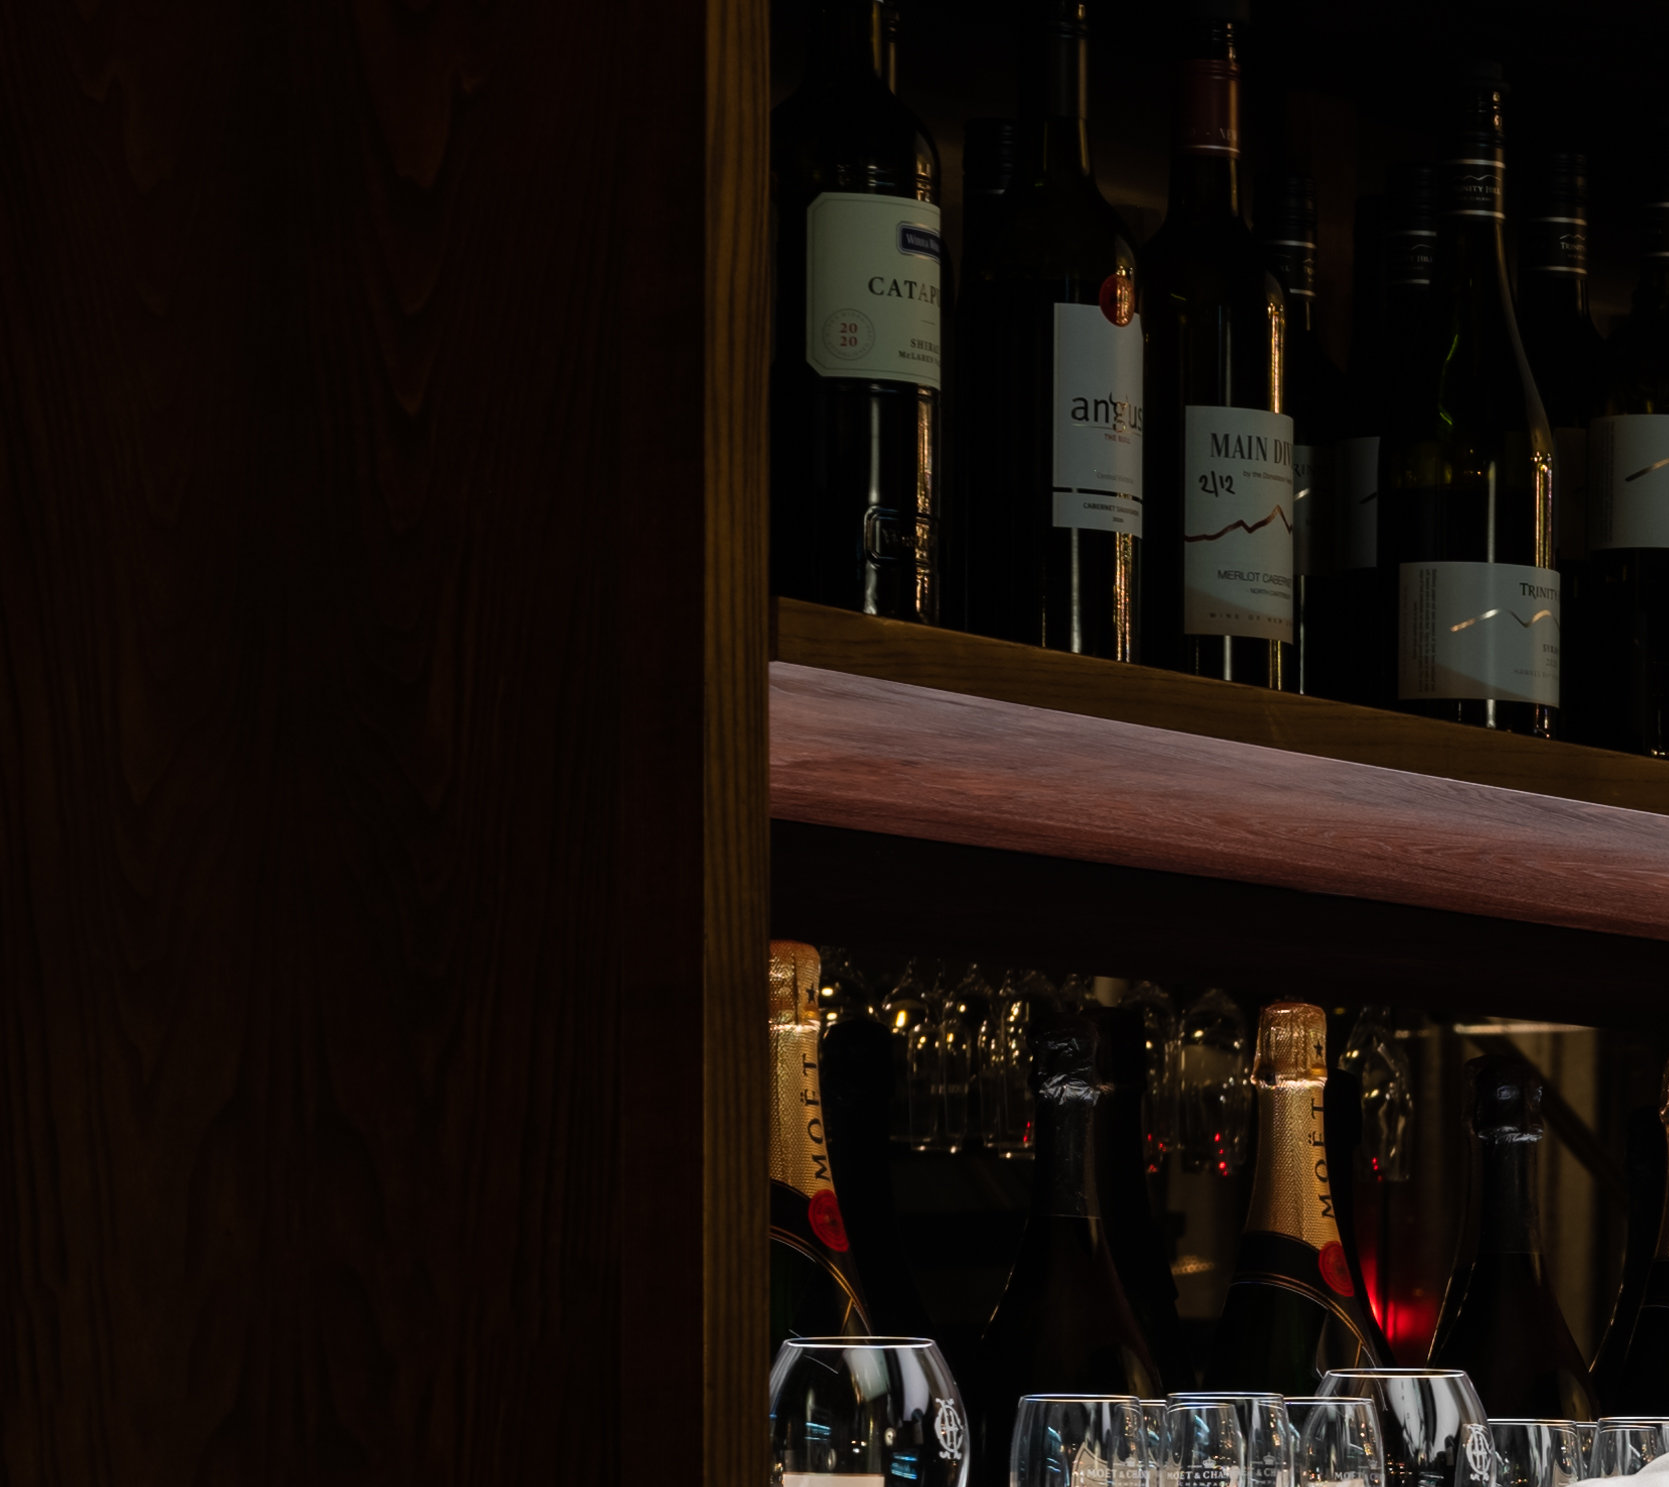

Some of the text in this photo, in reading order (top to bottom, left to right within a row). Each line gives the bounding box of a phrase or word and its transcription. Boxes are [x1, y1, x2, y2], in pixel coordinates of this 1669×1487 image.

[840, 322, 858, 334] 20
[840, 336, 858, 348] 20
[1209, 432, 1268, 462] MAIN
[1217, 569, 1261, 583] MERLOT
[800, 1053, 833, 1183] MOËT
[1310, 1097, 1338, 1221] MOËT
